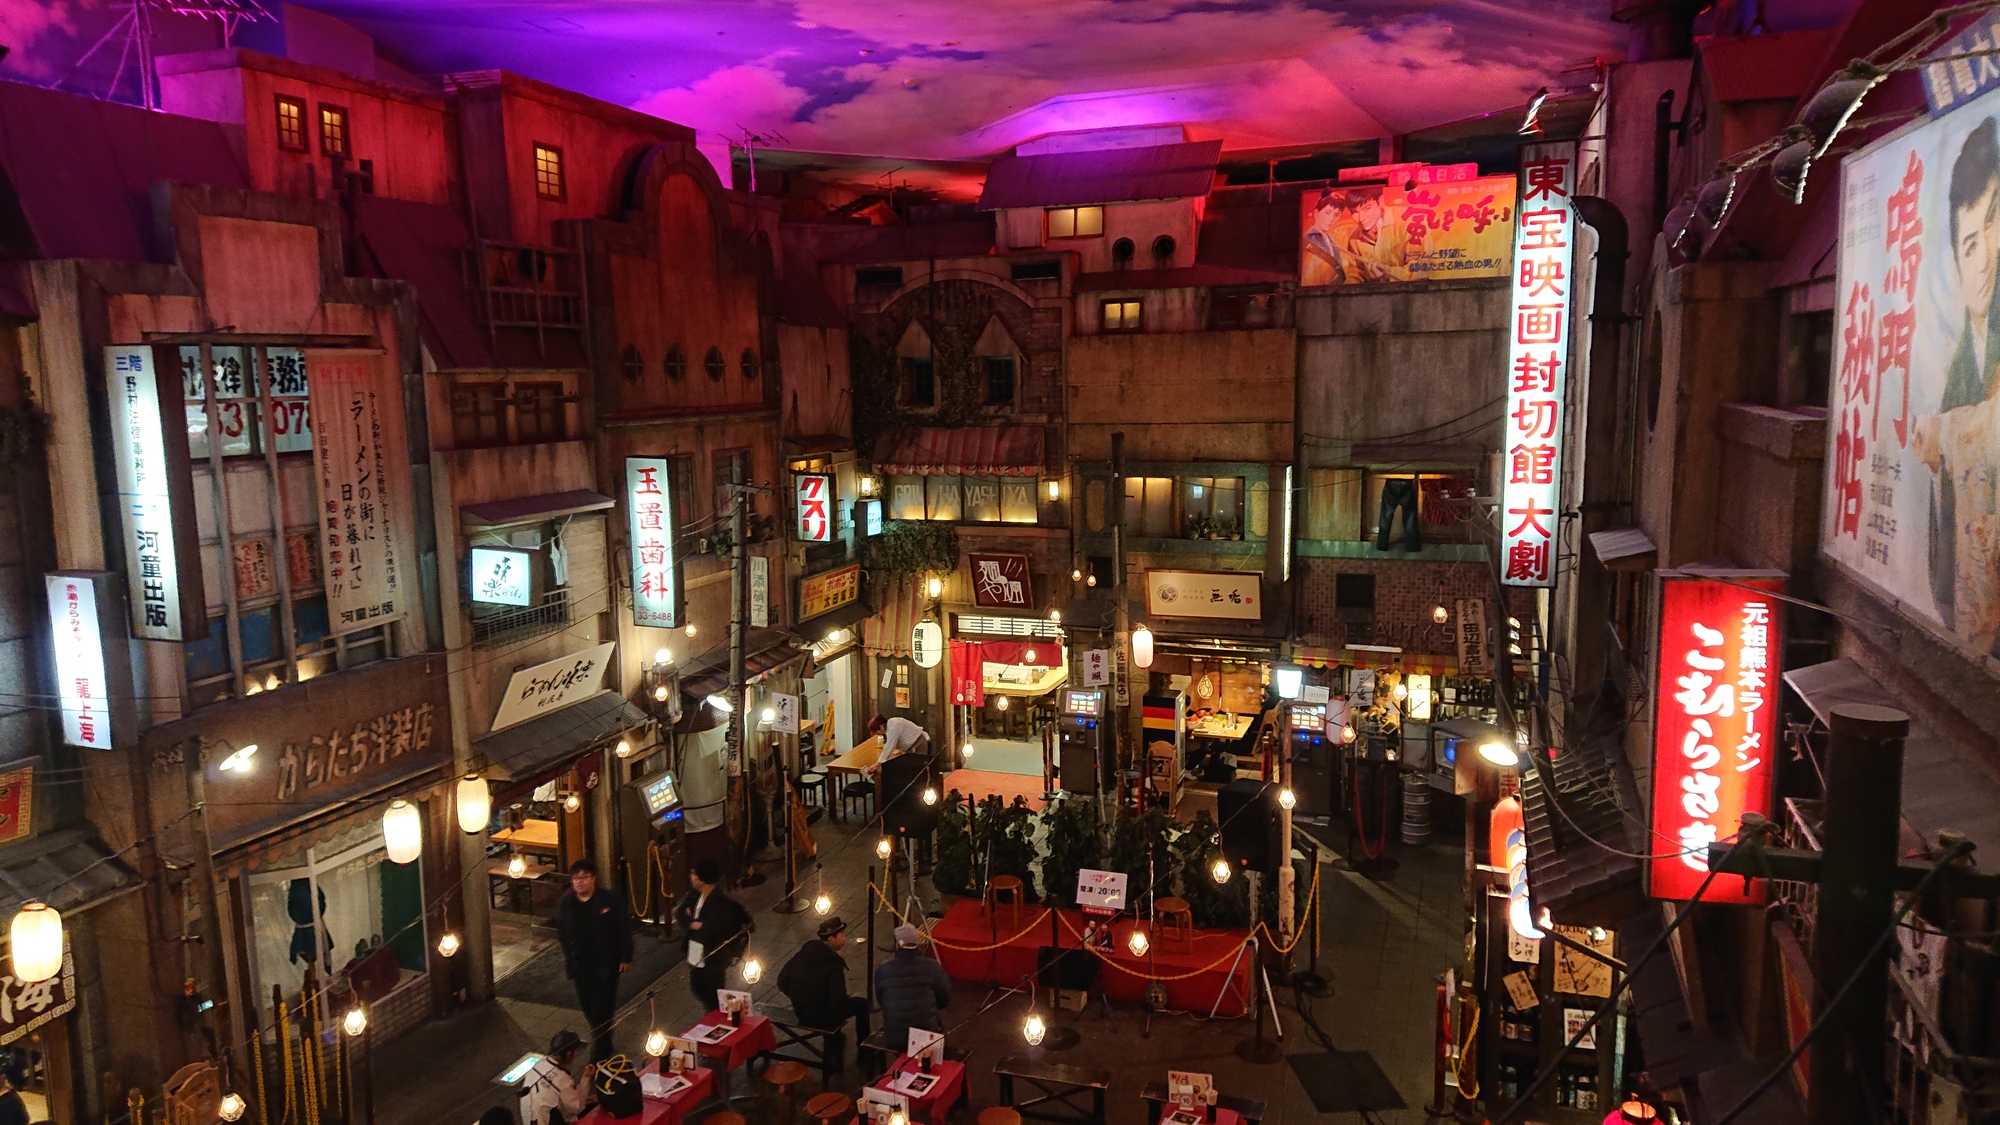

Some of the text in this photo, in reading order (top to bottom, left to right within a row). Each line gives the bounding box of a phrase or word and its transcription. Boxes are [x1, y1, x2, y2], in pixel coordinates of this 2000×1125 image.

[1873, 148, 1924, 450] 鳴門
[115, 353, 143, 373] 三階
[1506, 154, 1571, 583] 東宝映画封切館大劇
[1835, 278, 1875, 541] 秘帖
[635, 466, 669, 601] 玉置歯科
[800, 477, 826, 540] クスリ
[136, 528, 168, 628] 河童出版
[340, 601, 395, 625] 河童出版
[637, 611, 673, 622] 33-6488
[1462, 623, 1482, 666] 田辺書店
[1735, 602, 1770, 773] 元祖熊本ラーメン
[1674, 621, 1735, 873] こむらさき
